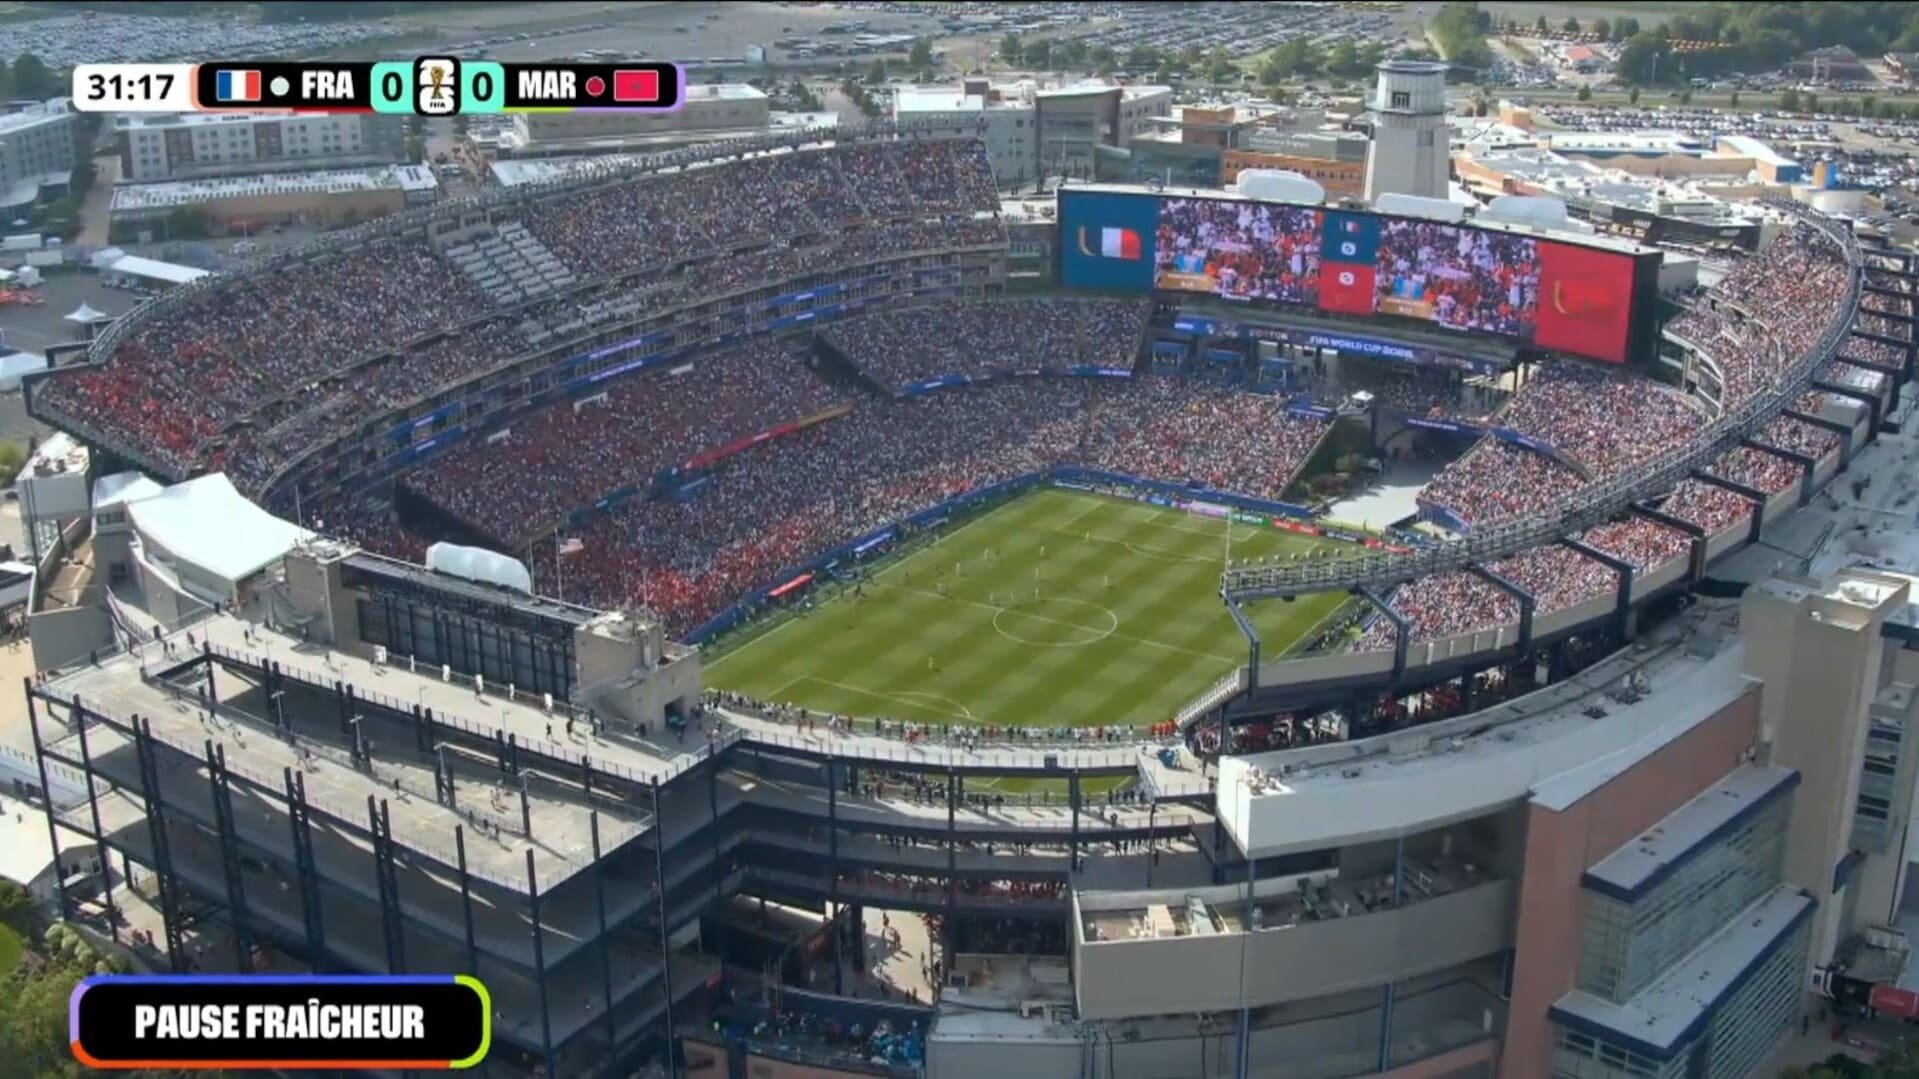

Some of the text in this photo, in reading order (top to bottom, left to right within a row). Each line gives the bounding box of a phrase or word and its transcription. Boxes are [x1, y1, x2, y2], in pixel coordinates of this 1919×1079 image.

[1310, 335, 1329, 346] FIFA
[1330, 338, 1362, 350] WORLD
[1363, 342, 1382, 353] CUP
